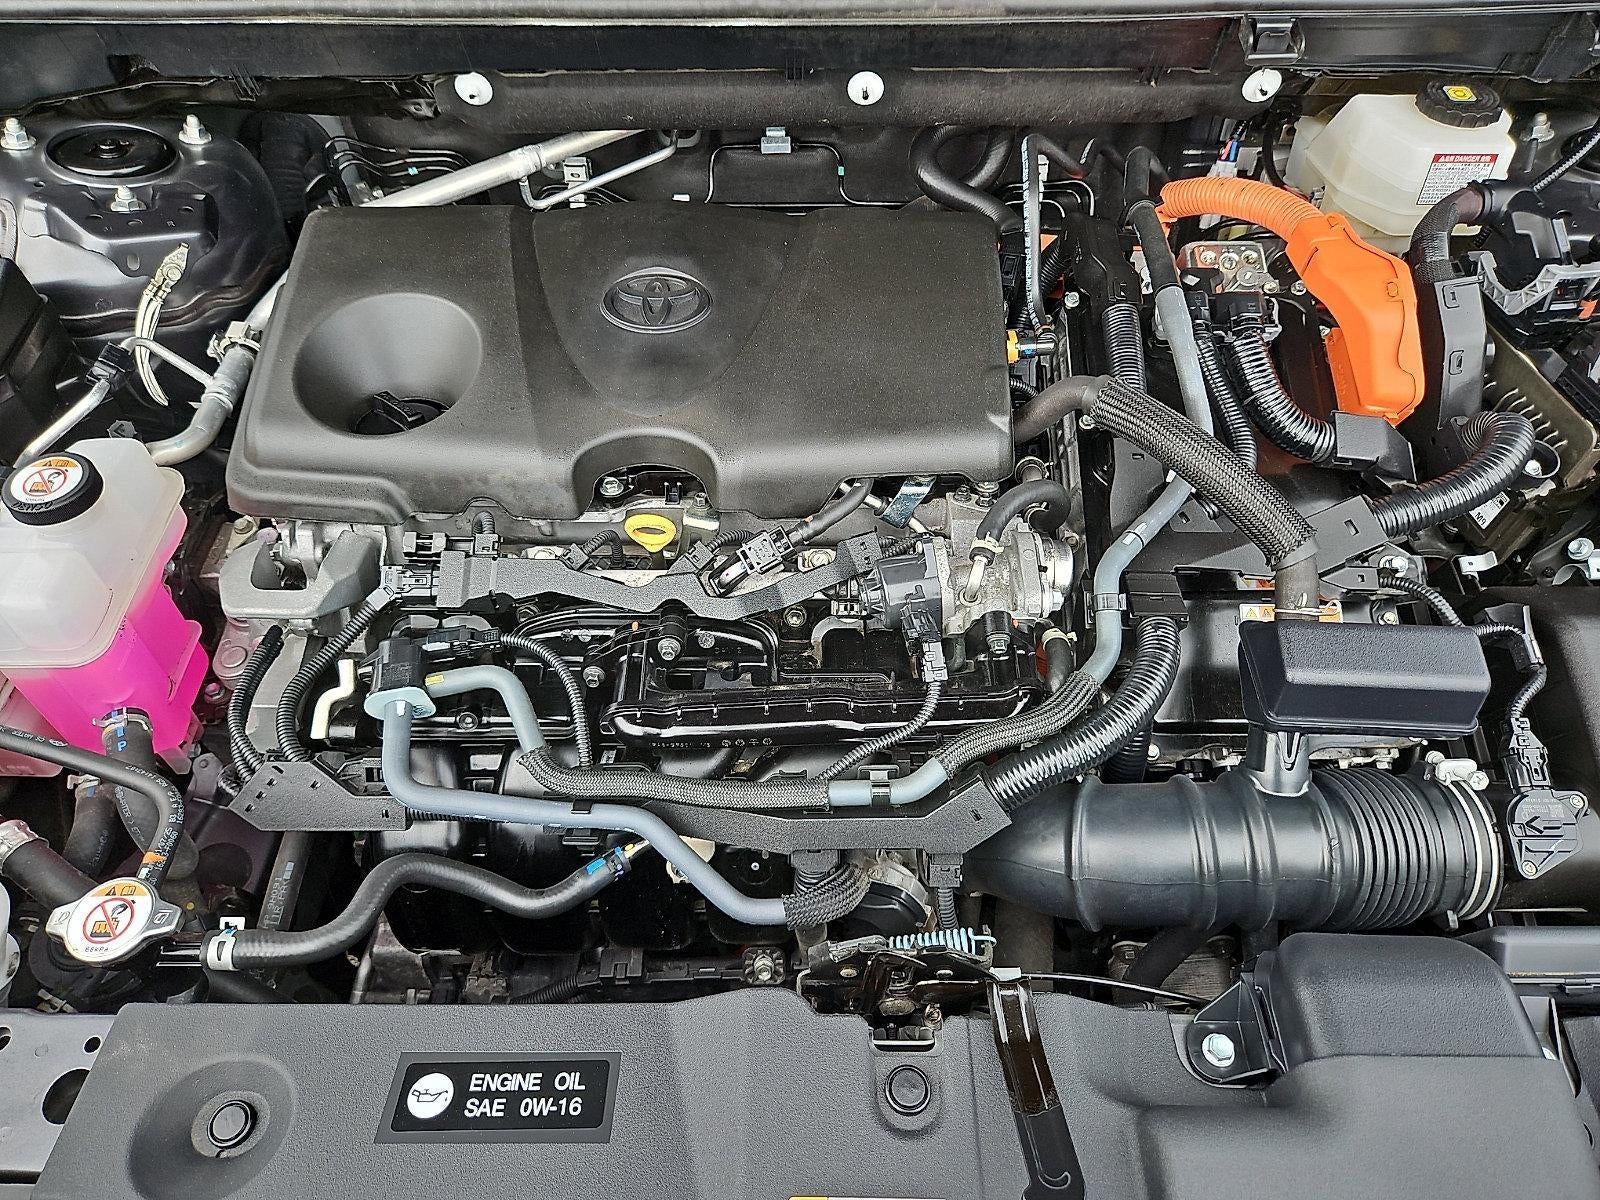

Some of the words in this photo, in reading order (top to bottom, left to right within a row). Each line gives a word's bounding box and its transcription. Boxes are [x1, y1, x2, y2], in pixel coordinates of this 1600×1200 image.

[1475, 512, 1487, 526] M9
[117, 740, 127, 752] P
[468, 1072, 543, 1092] ENGINE
[554, 1071, 586, 1091] OIL
[463, 1098, 507, 1118] SAE
[519, 1097, 582, 1117] 0W-16
